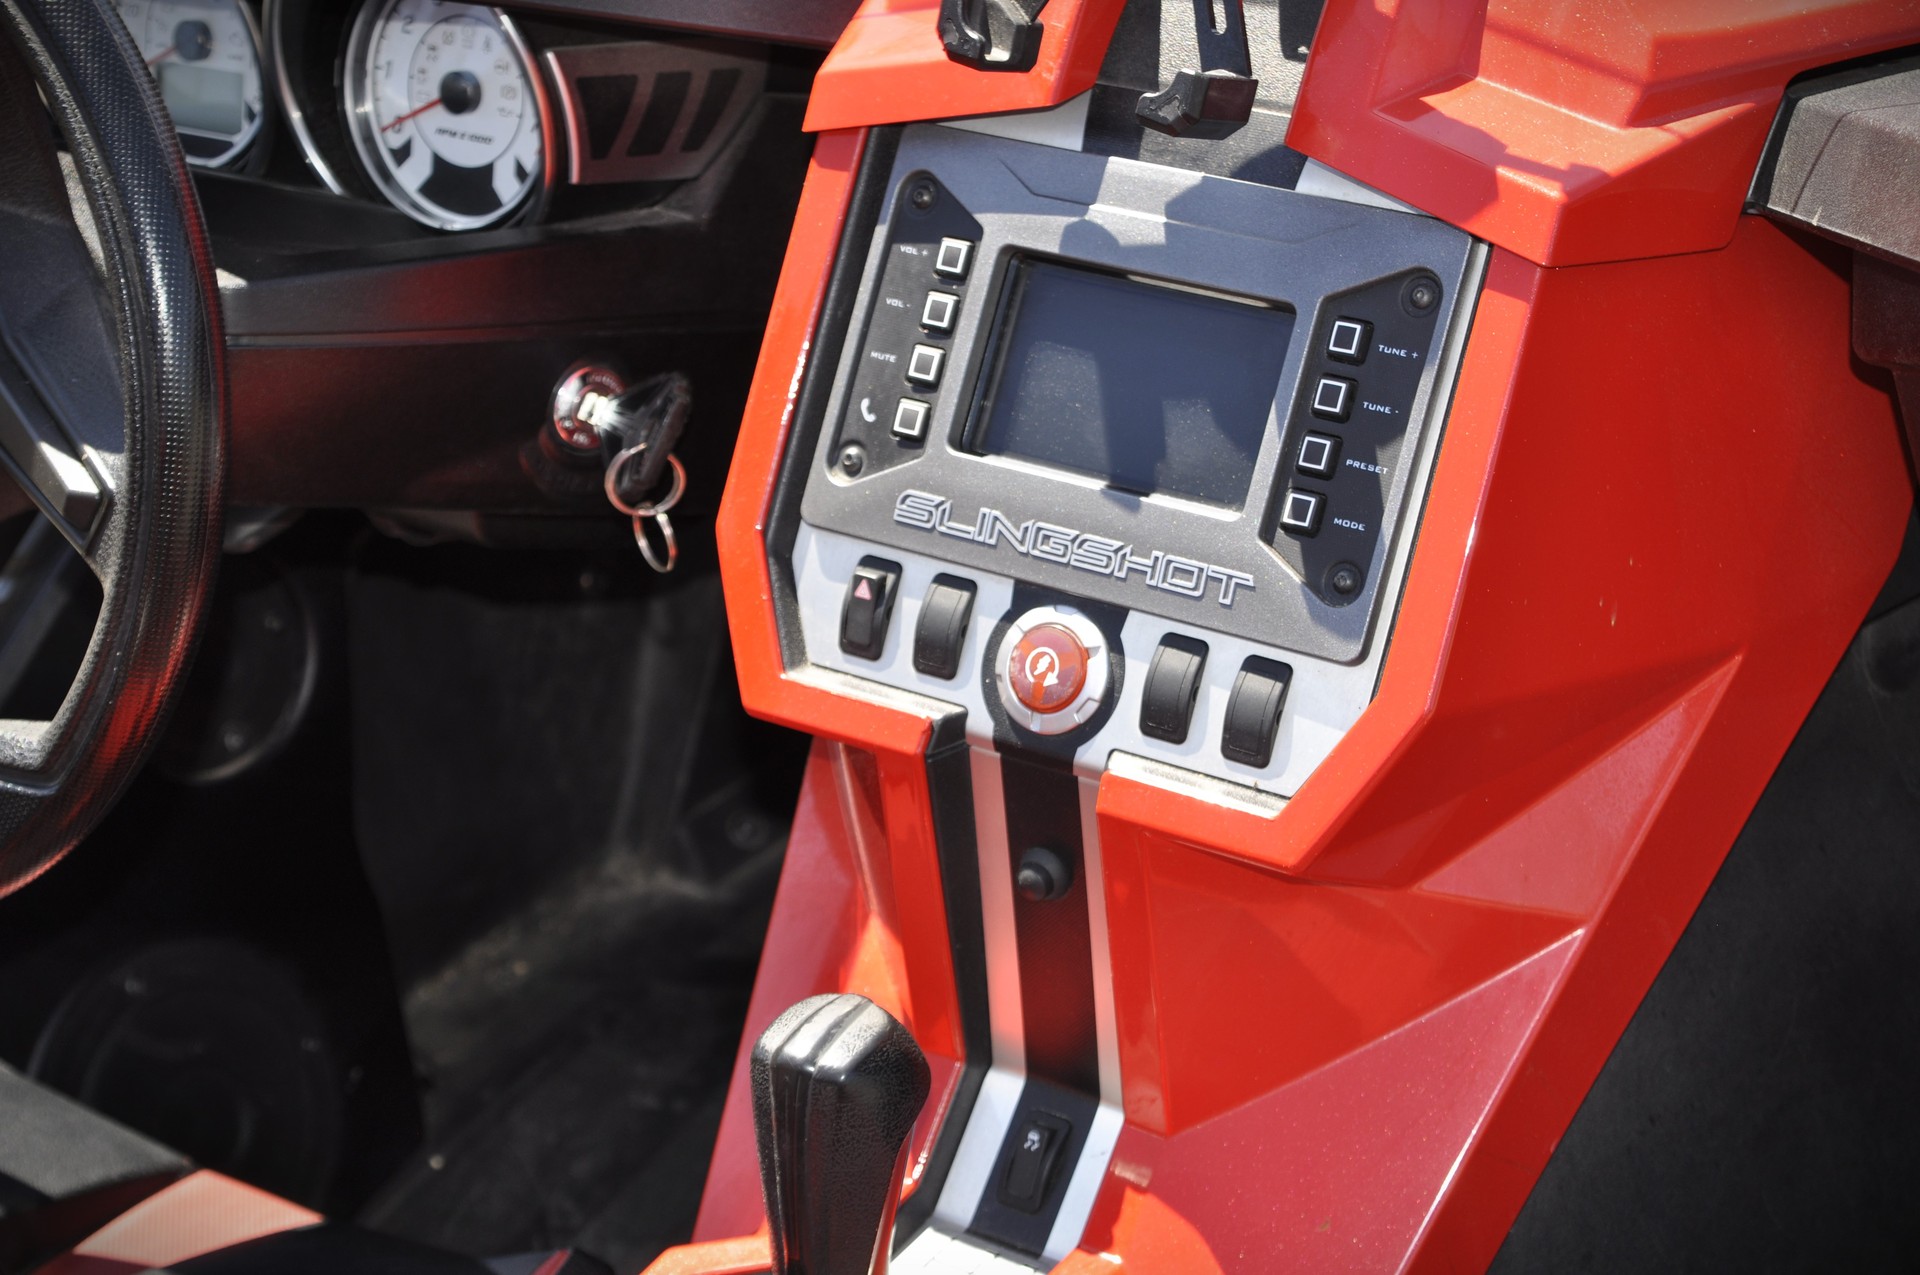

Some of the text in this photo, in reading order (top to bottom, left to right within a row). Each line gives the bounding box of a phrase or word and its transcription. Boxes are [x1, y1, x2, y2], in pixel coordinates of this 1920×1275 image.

[402, 15, 413, 34] 2
[385, 61, 392, 79] 1
[900, 245, 919, 256] VOL
[886, 298, 904, 308] VOL
[870, 351, 897, 363] MUTE
[1378, 344, 1419, 359] TUNE +
[1363, 401, 1392, 414] TUNE
[1345, 458, 1389, 475] PRESET
[1333, 517, 1366, 531] MODE
[893, 488, 1255, 606] SLINGSHOT
